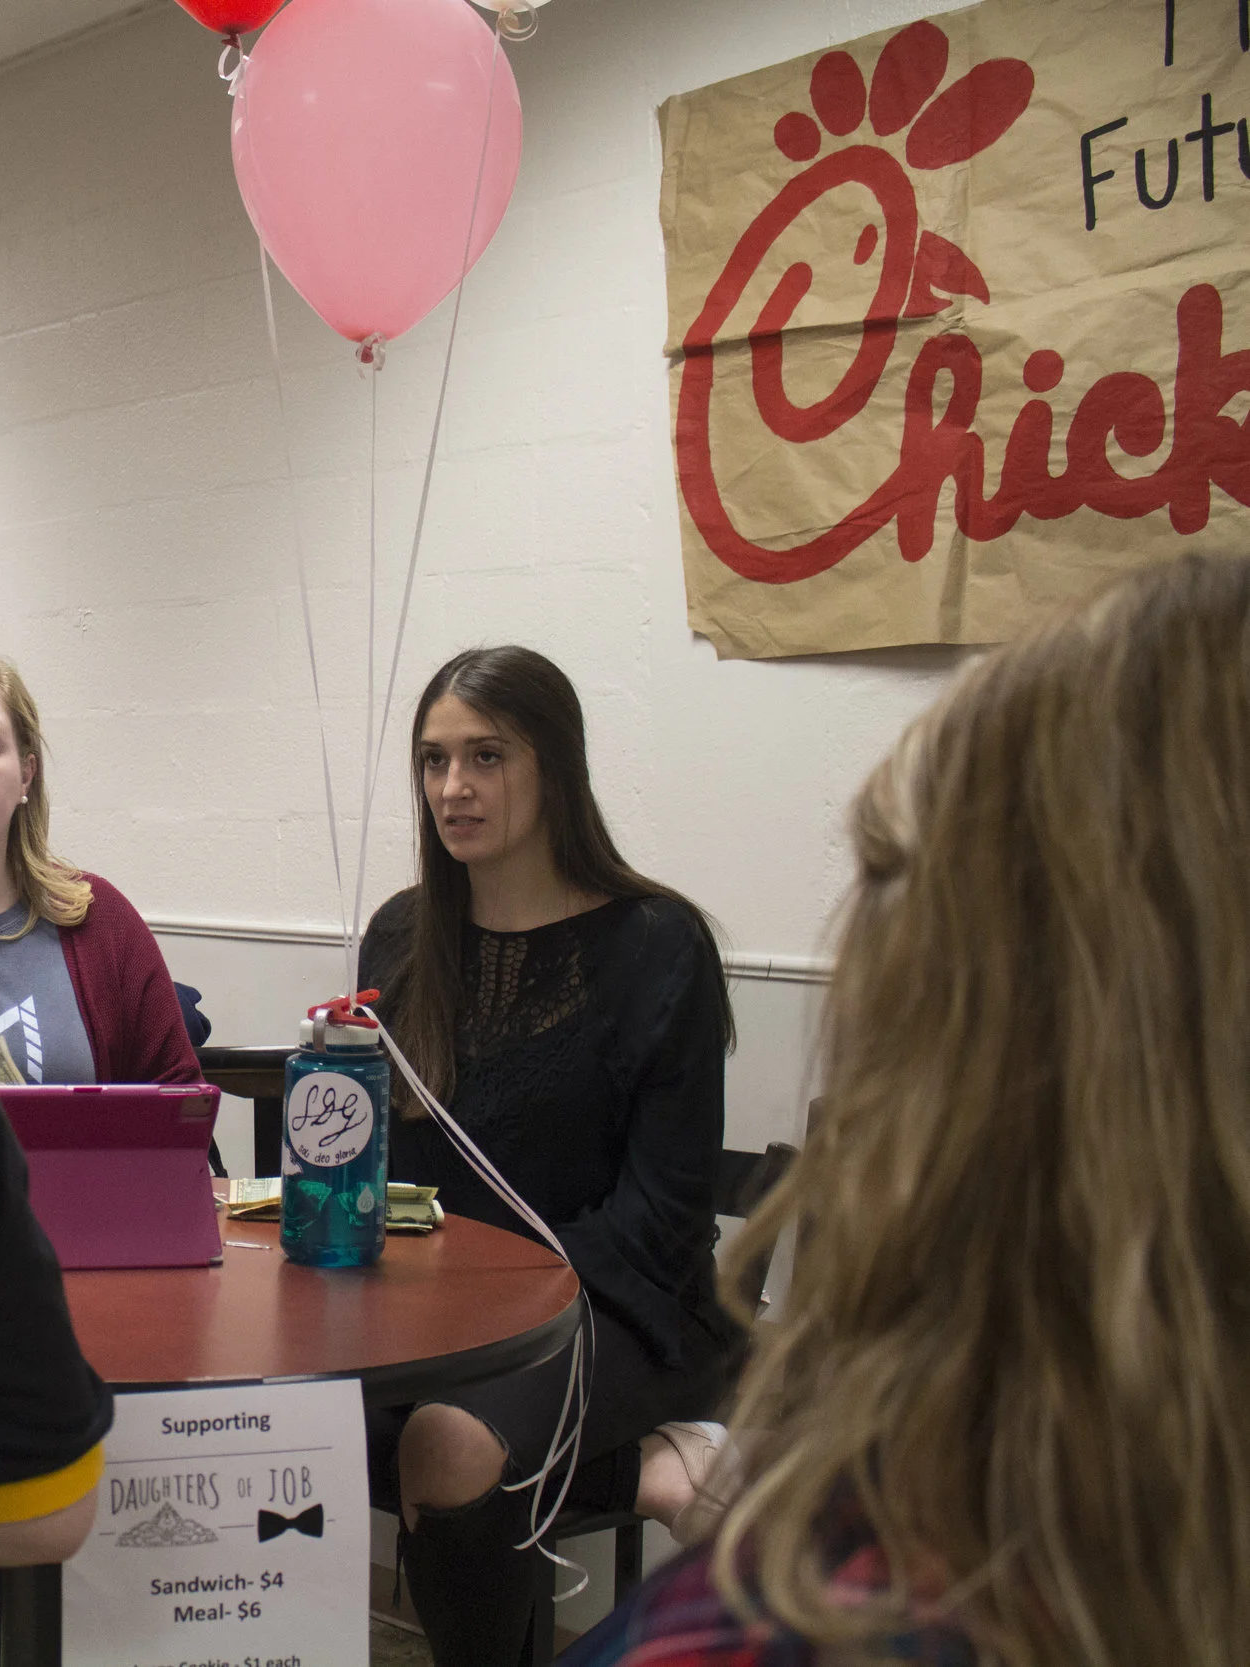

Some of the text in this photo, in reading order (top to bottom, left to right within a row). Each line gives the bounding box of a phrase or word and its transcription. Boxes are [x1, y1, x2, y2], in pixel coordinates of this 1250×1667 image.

[314, 1153, 330, 1163] deo
[161, 1412, 271, 1437] Supporting
[111, 1465, 313, 1515] DAUGHTERS OF JOB
[260, 1570, 284, 1591] $4
[237, 1600, 262, 1621] $6
